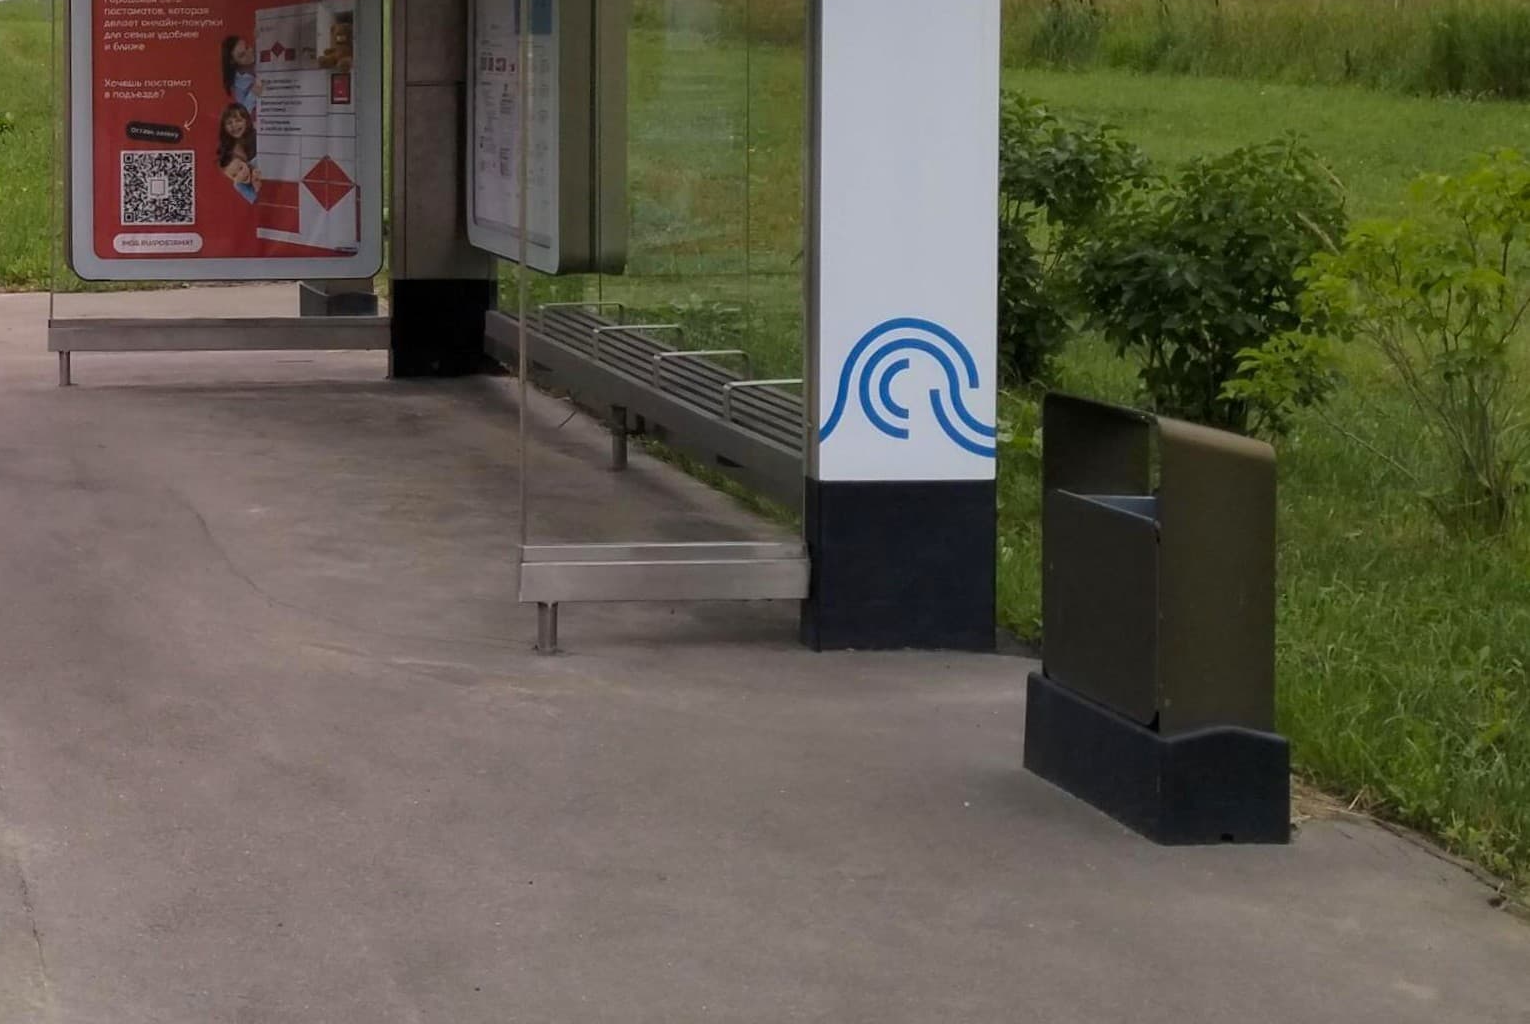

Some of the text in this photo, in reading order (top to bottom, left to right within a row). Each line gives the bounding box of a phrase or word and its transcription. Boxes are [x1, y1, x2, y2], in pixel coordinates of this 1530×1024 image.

[104, 7, 210, 16] постаматов, которая
[104, 19, 139, 28] делает
[113, 41, 145, 51] ближе
[104, 79, 191, 88] Хочешь постамат
